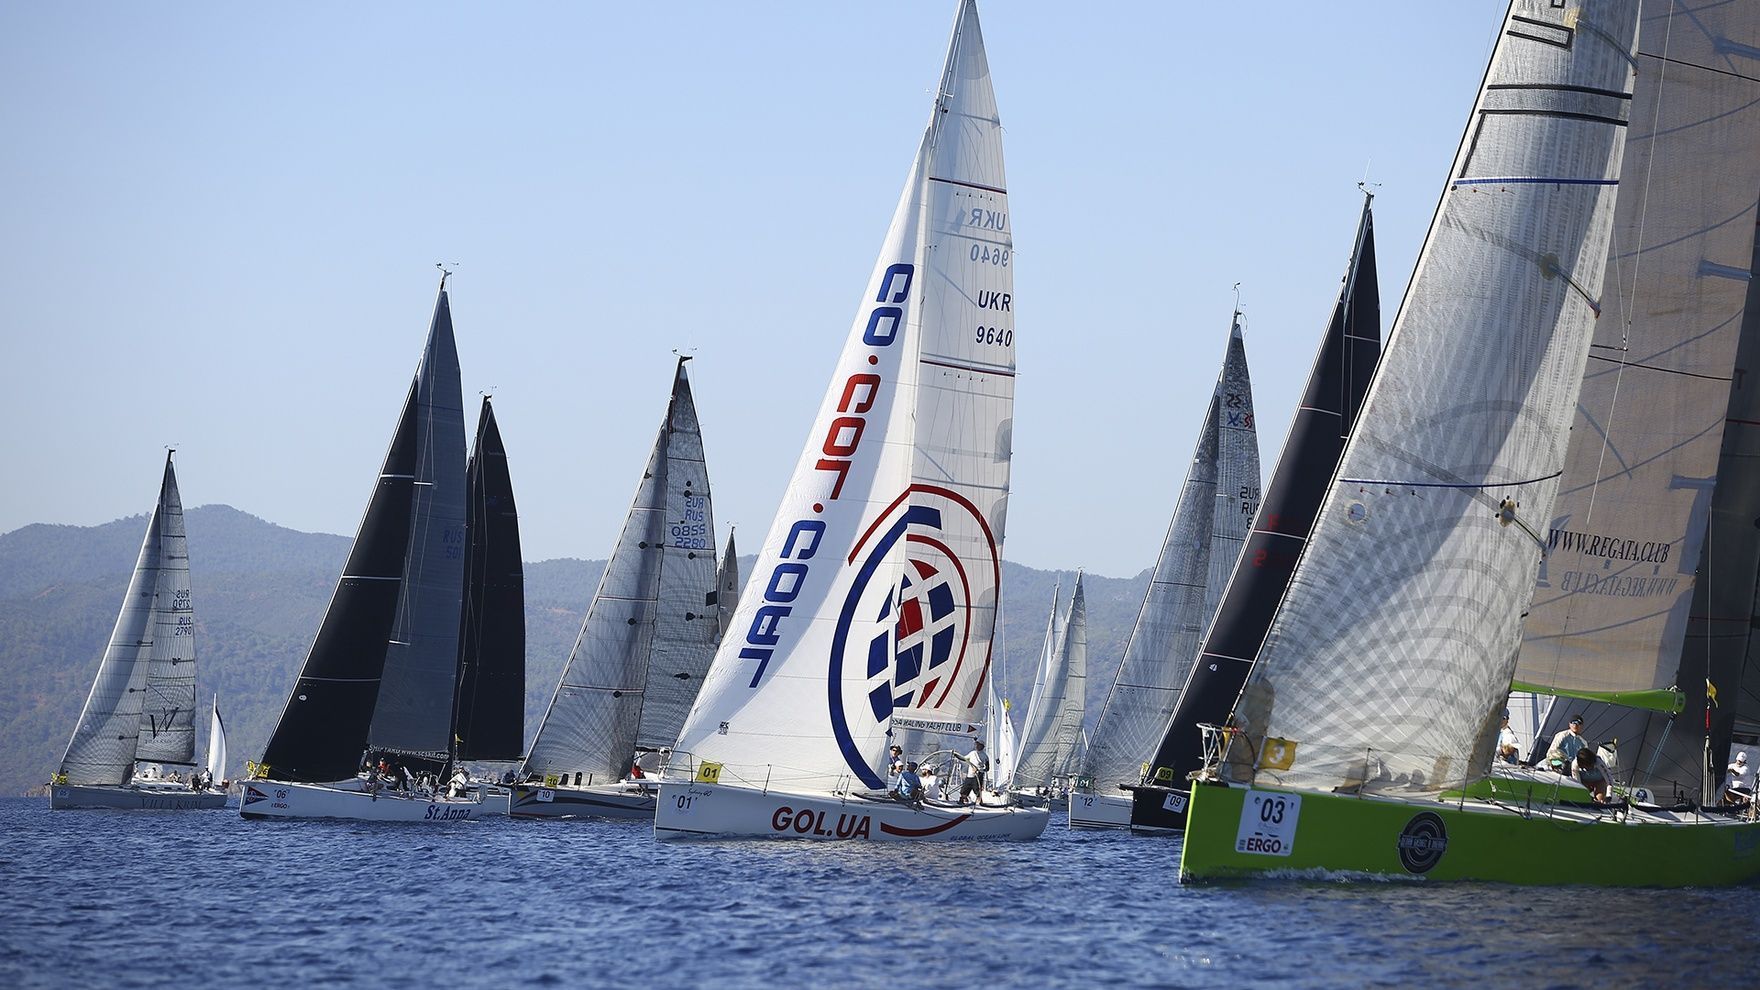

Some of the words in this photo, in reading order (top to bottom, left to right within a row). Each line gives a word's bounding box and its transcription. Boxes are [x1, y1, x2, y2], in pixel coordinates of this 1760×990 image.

[977, 290, 1012, 311] UKR
[975, 326, 1013, 347] 9640
[685, 509, 704, 521] RUS
[674, 536, 706, 548] 2280
[1548, 528, 1671, 563] WWW.REGATA.CLUB
[703, 767, 717, 779] 01
[542, 790, 551, 799] 10
[1083, 797, 1094, 807] 12
[1169, 796, 1182, 807] 09
[677, 795, 692, 810] 01
[1260, 798, 1286, 824] 03
[771, 806, 871, 840] GOL.UA
[1246, 838, 1281, 853] ERGO
